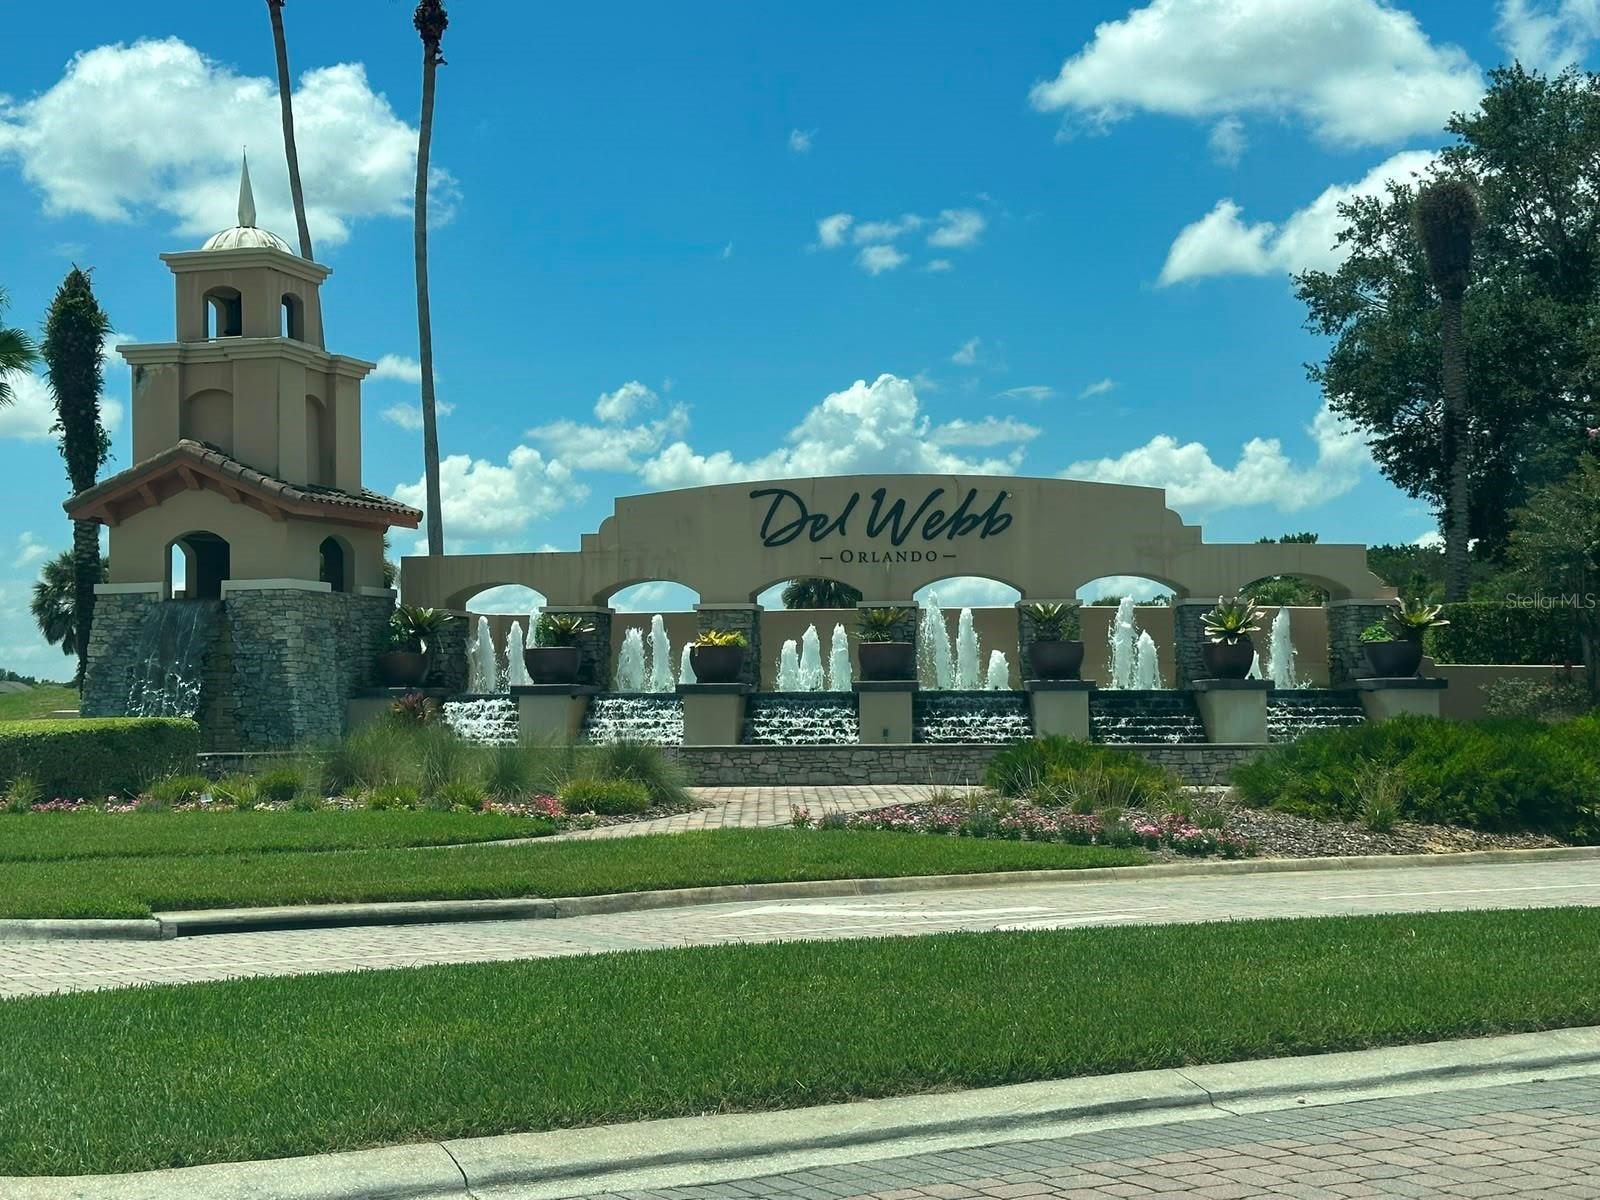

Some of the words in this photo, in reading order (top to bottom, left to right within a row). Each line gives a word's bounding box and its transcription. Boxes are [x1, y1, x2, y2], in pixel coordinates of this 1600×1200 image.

[750, 488, 860, 547] Del
[866, 487, 1013, 546] Webb
[840, 550, 937, 563] ORLANDO
